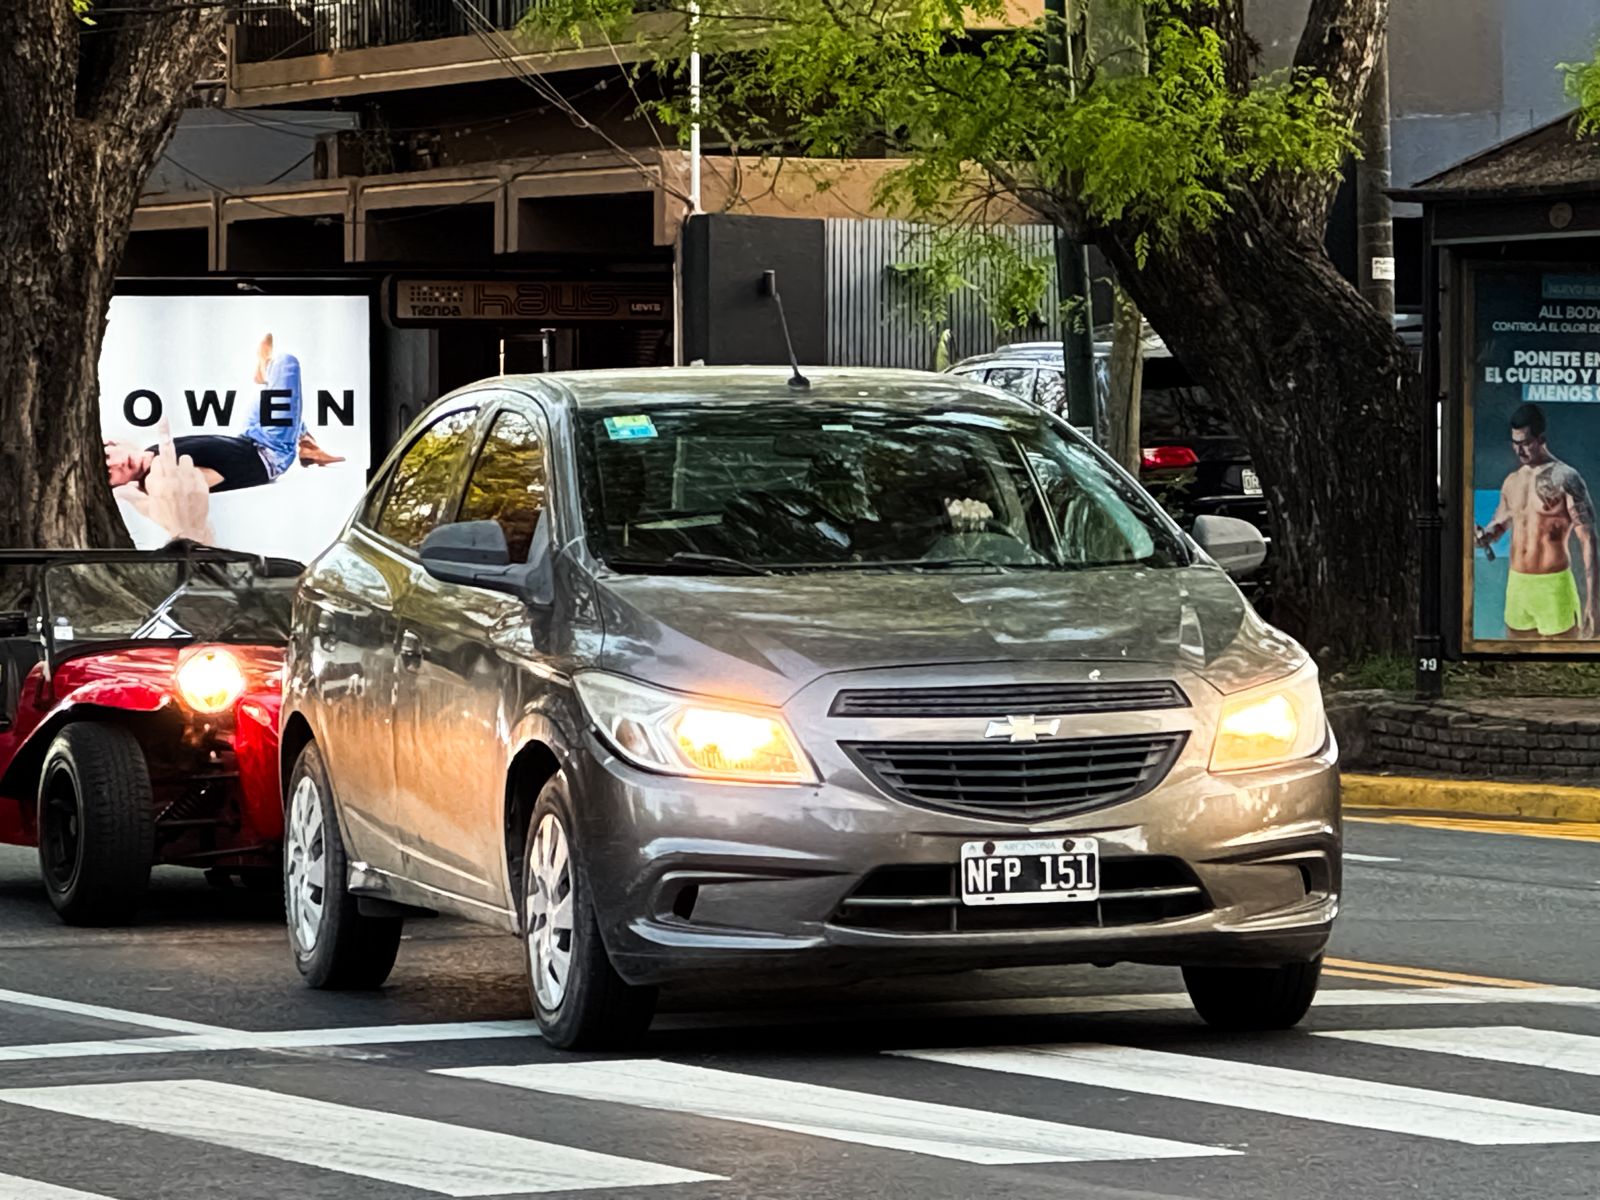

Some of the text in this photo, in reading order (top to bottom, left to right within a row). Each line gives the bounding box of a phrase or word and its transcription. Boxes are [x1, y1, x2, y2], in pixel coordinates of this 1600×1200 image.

[1539, 305, 1563, 318] ALL
[1492, 321, 1547, 332] CONTROLA
[1549, 322, 1559, 332] EL
[1560, 323, 1587, 333] OLOR
[1514, 351, 1581, 366] PONETE
[1485, 367, 1503, 383] EL
[1505, 367, 1577, 383] CUERPO
[1580, 369, 1593, 383] Y
[1528, 385, 1593, 401] MENOS
[1419, 657, 1437, 671] 39
[967, 854, 1093, 892] NFP 151
